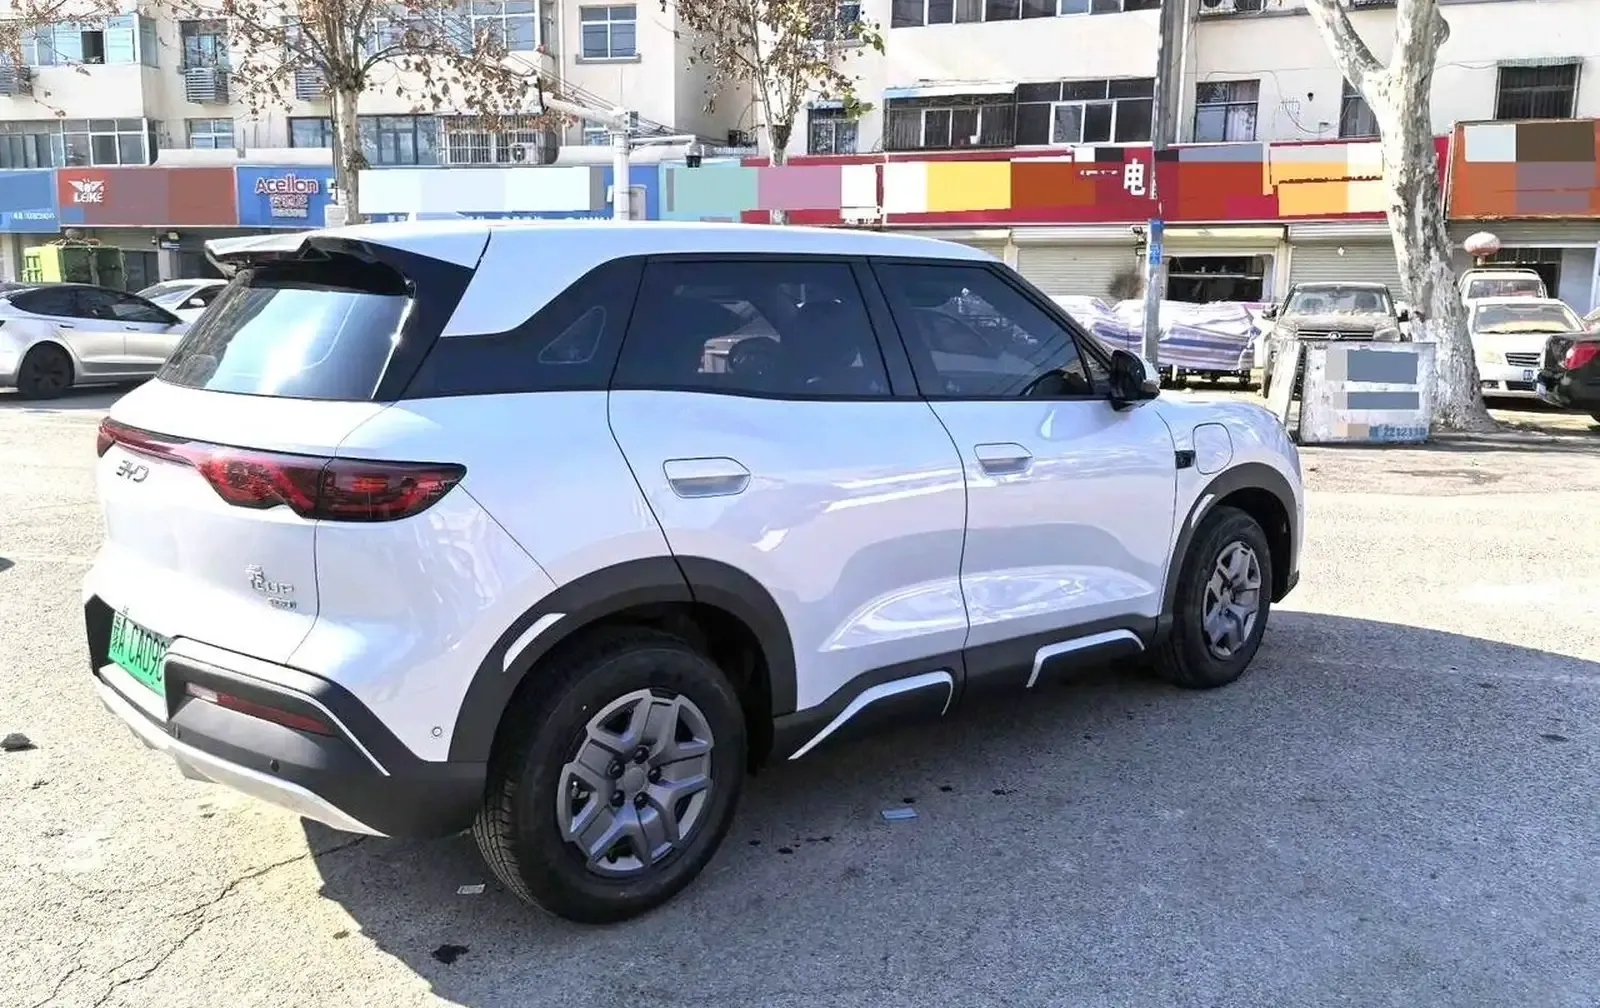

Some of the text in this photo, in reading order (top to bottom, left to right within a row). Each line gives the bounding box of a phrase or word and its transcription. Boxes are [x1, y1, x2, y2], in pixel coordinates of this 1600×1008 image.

[254, 173, 319, 194] Acellon
[1123, 158, 1146, 196] 电
[73, 192, 105, 203] LEIKE
